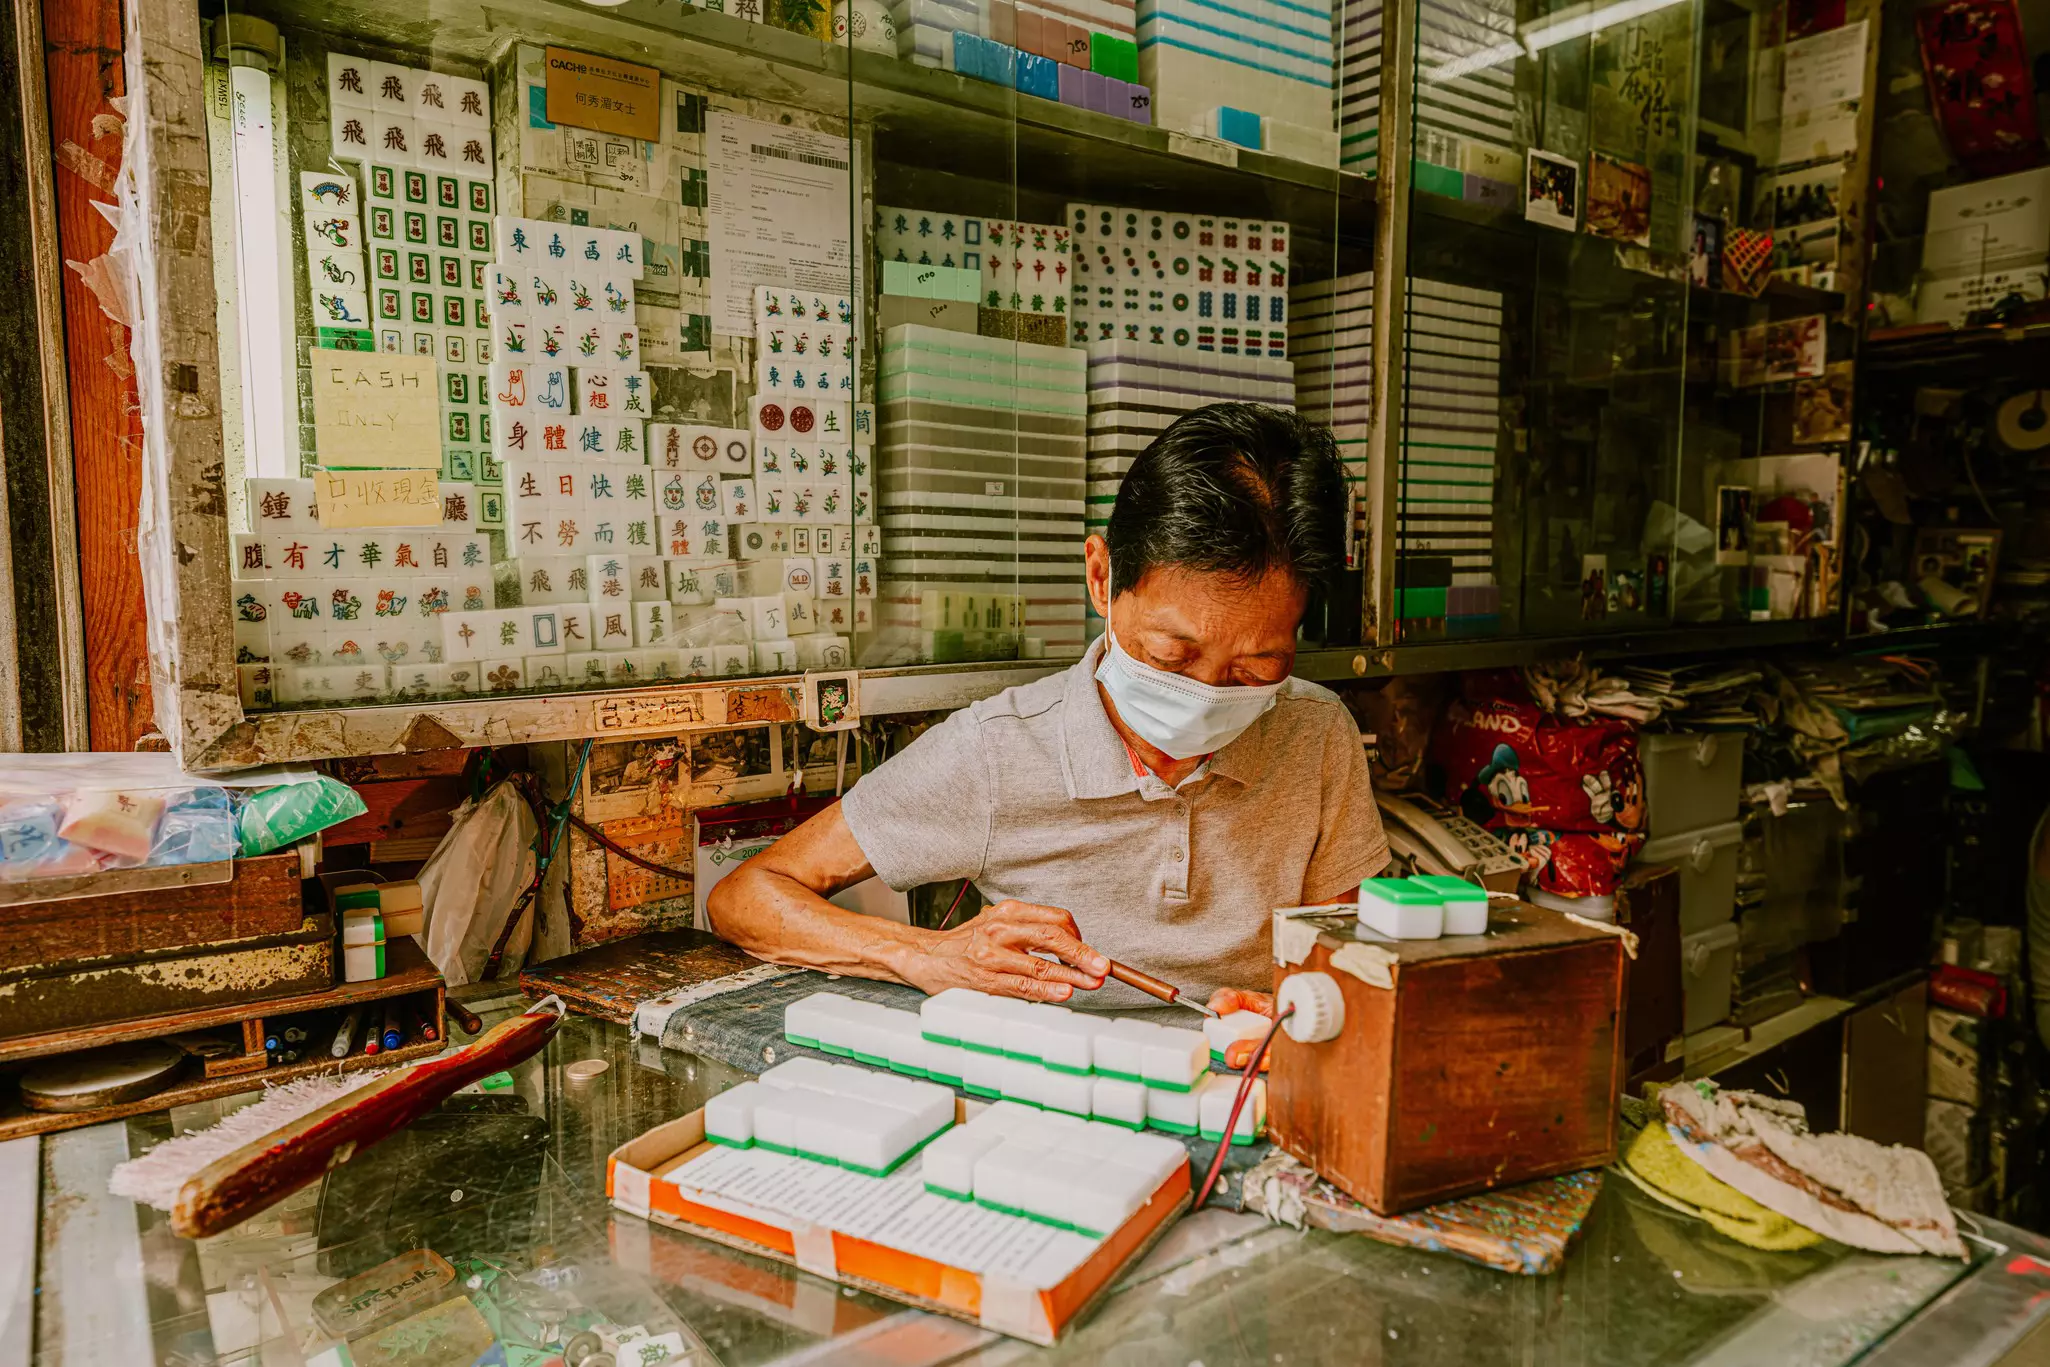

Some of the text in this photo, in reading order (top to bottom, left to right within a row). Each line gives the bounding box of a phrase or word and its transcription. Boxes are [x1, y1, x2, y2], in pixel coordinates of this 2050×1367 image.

[1067, 40, 1087, 54] 750
[496, 273, 614, 293] 1 2 3 4
[791, 295, 796, 304] 2
[814, 298, 819, 307] 3
[838, 300, 845, 309] 4
[330, 368, 419, 388] CASH
[588, 374, 609, 409] 心想
[624, 375, 644, 413] 事成
[337, 409, 398, 431] ONLY
[824, 411, 840, 432] 生
[856, 410, 871, 435] 筒
[508, 421, 639, 452] 身體健康
[791, 448, 796, 458] 2
[819, 449, 825, 458] 3
[328, 476, 437, 512] 只收現金
[520, 471, 647, 500] 生日快樂
[521, 520, 650, 547] 不勞而獲
[671, 520, 691, 556] 身體
[702, 520, 722, 555] 健康
[242, 541, 484, 571] 腹有才華氣自豪
[599, 560, 624, 596] 香港
[603, 614, 626, 638] 風
[338, 1267, 438, 1319] Strepsils
